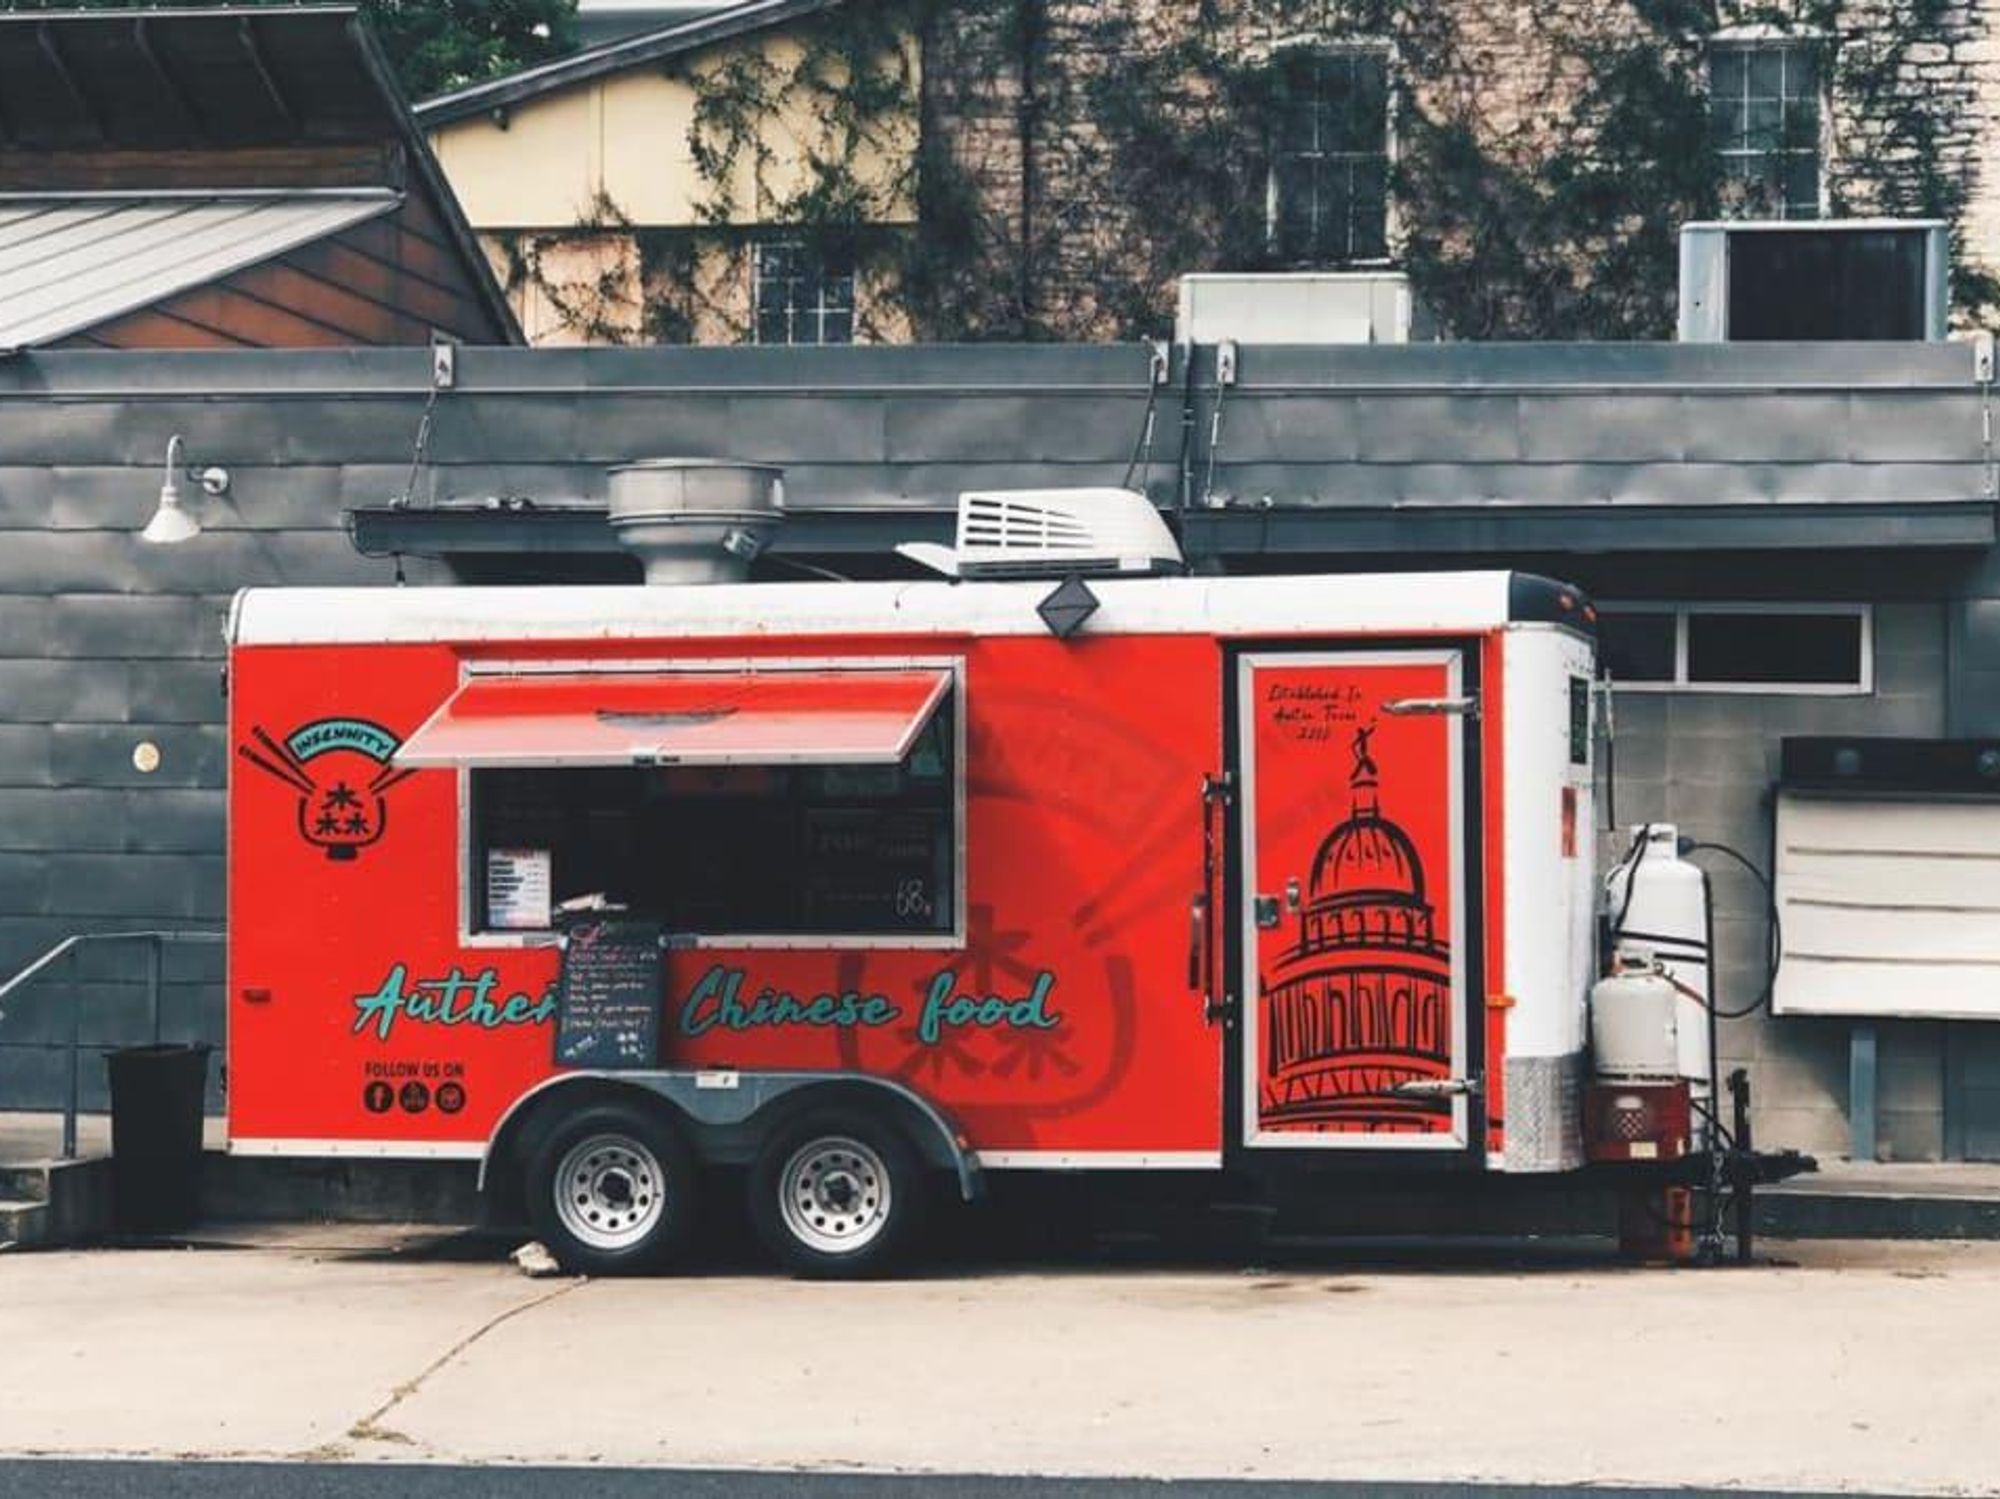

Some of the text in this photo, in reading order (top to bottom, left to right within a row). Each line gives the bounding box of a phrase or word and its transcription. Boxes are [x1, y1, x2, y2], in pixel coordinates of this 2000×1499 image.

[680, 965, 901, 1036] Chinese
[917, 969, 1061, 1043] food
[364, 1061, 464, 1078] FOLLOW US ON
